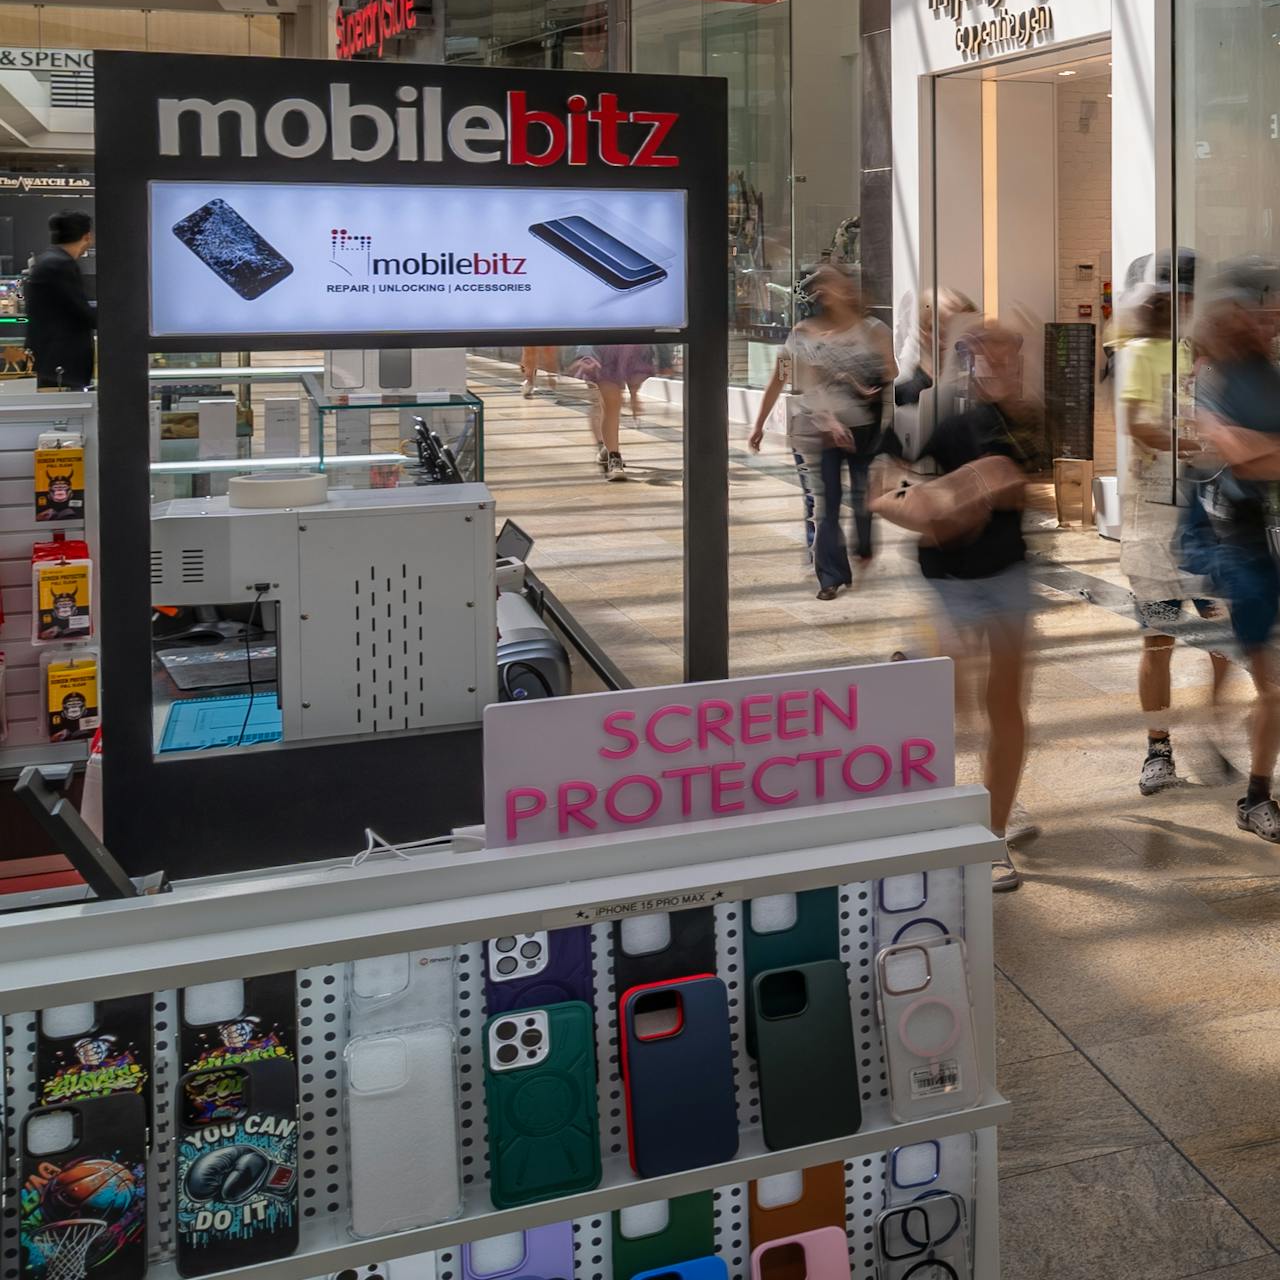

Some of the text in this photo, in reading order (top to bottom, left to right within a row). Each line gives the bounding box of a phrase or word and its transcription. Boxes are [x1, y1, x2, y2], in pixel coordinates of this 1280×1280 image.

[954, 3, 1053, 62] copenhagen
[157, 82, 681, 168] mobilebitz
[373, 252, 527, 275] mobilebitz
[326, 283, 532, 293] REPAIR UNLOCKING ACCESSORIES
[599, 684, 859, 760] SCREEN
[505, 738, 938, 841] PROTECTOR
[642, 902, 653, 910] 15
[656, 898, 680, 908] PRO
[682, 892, 705, 904] MAX
[185, 1115, 296, 1149] YOU CAN
[195, 1200, 268, 1231] DO IT
